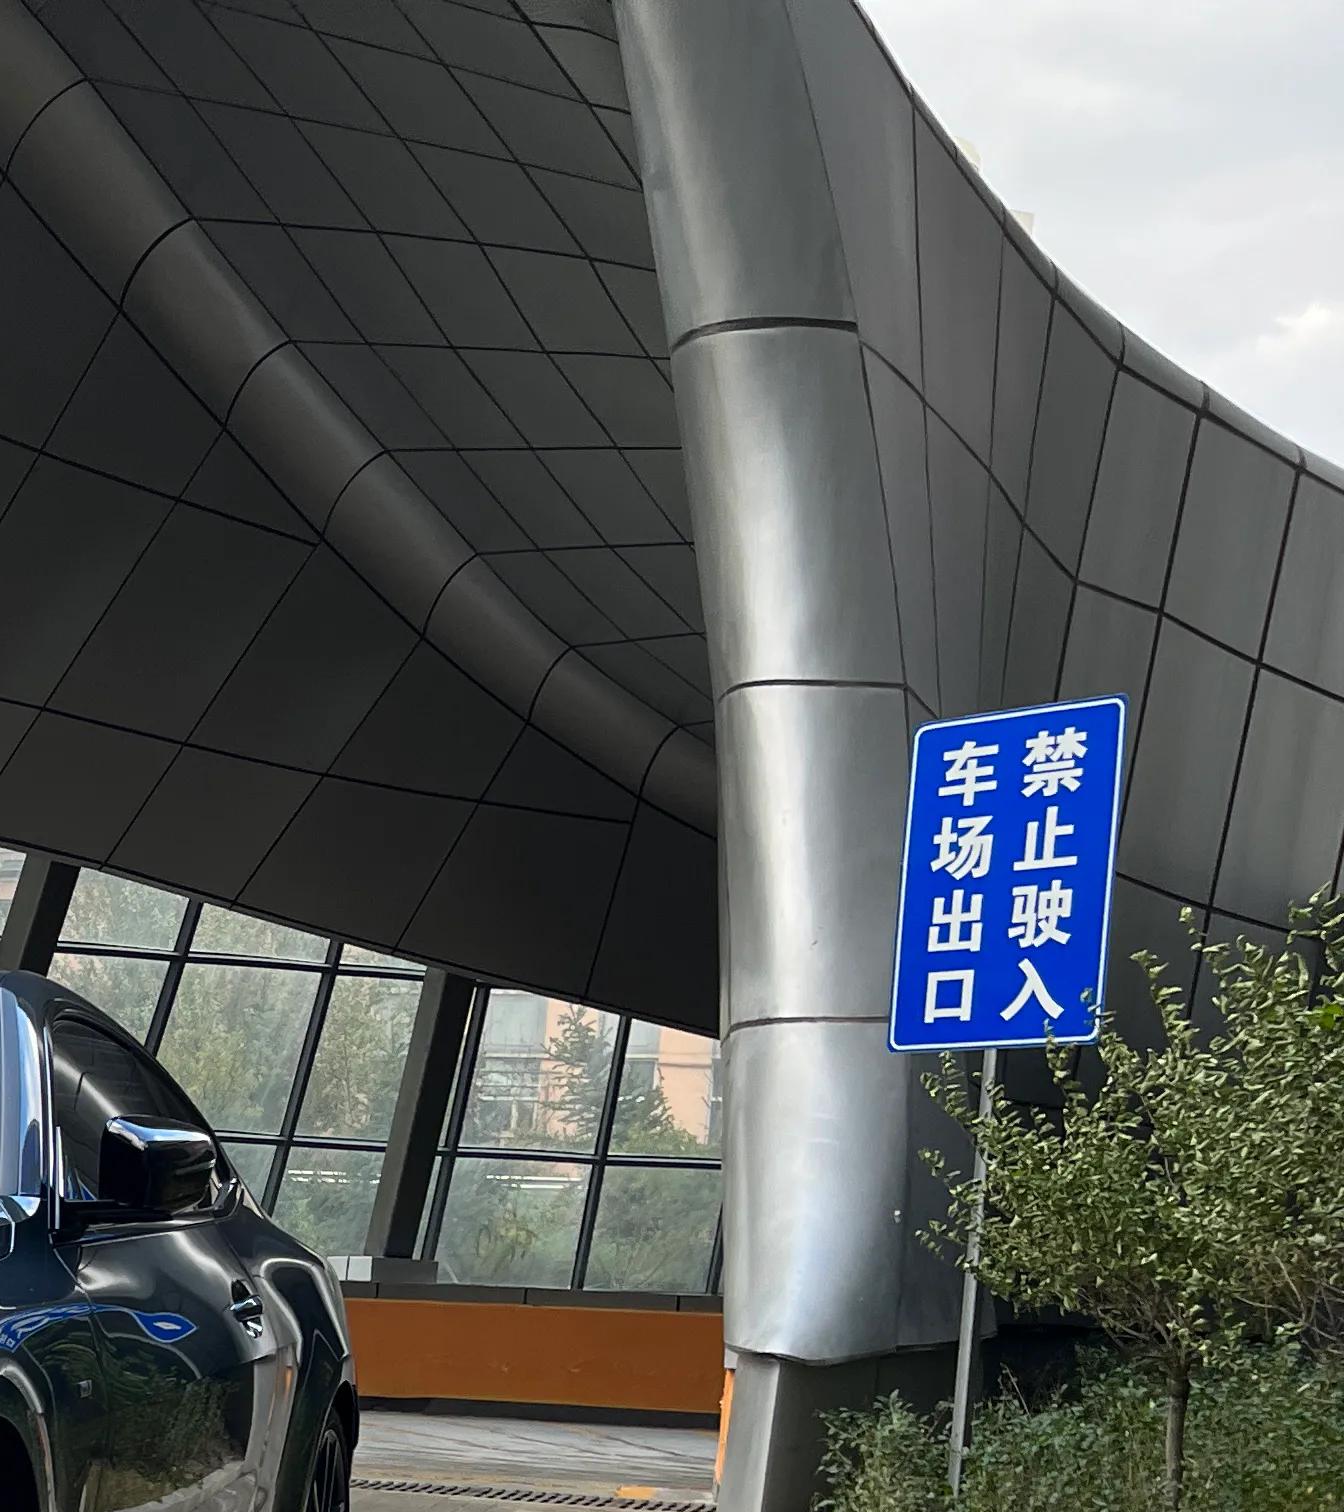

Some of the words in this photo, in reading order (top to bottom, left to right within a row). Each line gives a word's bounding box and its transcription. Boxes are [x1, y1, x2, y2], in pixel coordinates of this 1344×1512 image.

[923, 740, 999, 1024] 车场出口
[999, 726, 1088, 1022] 禁止驶入
